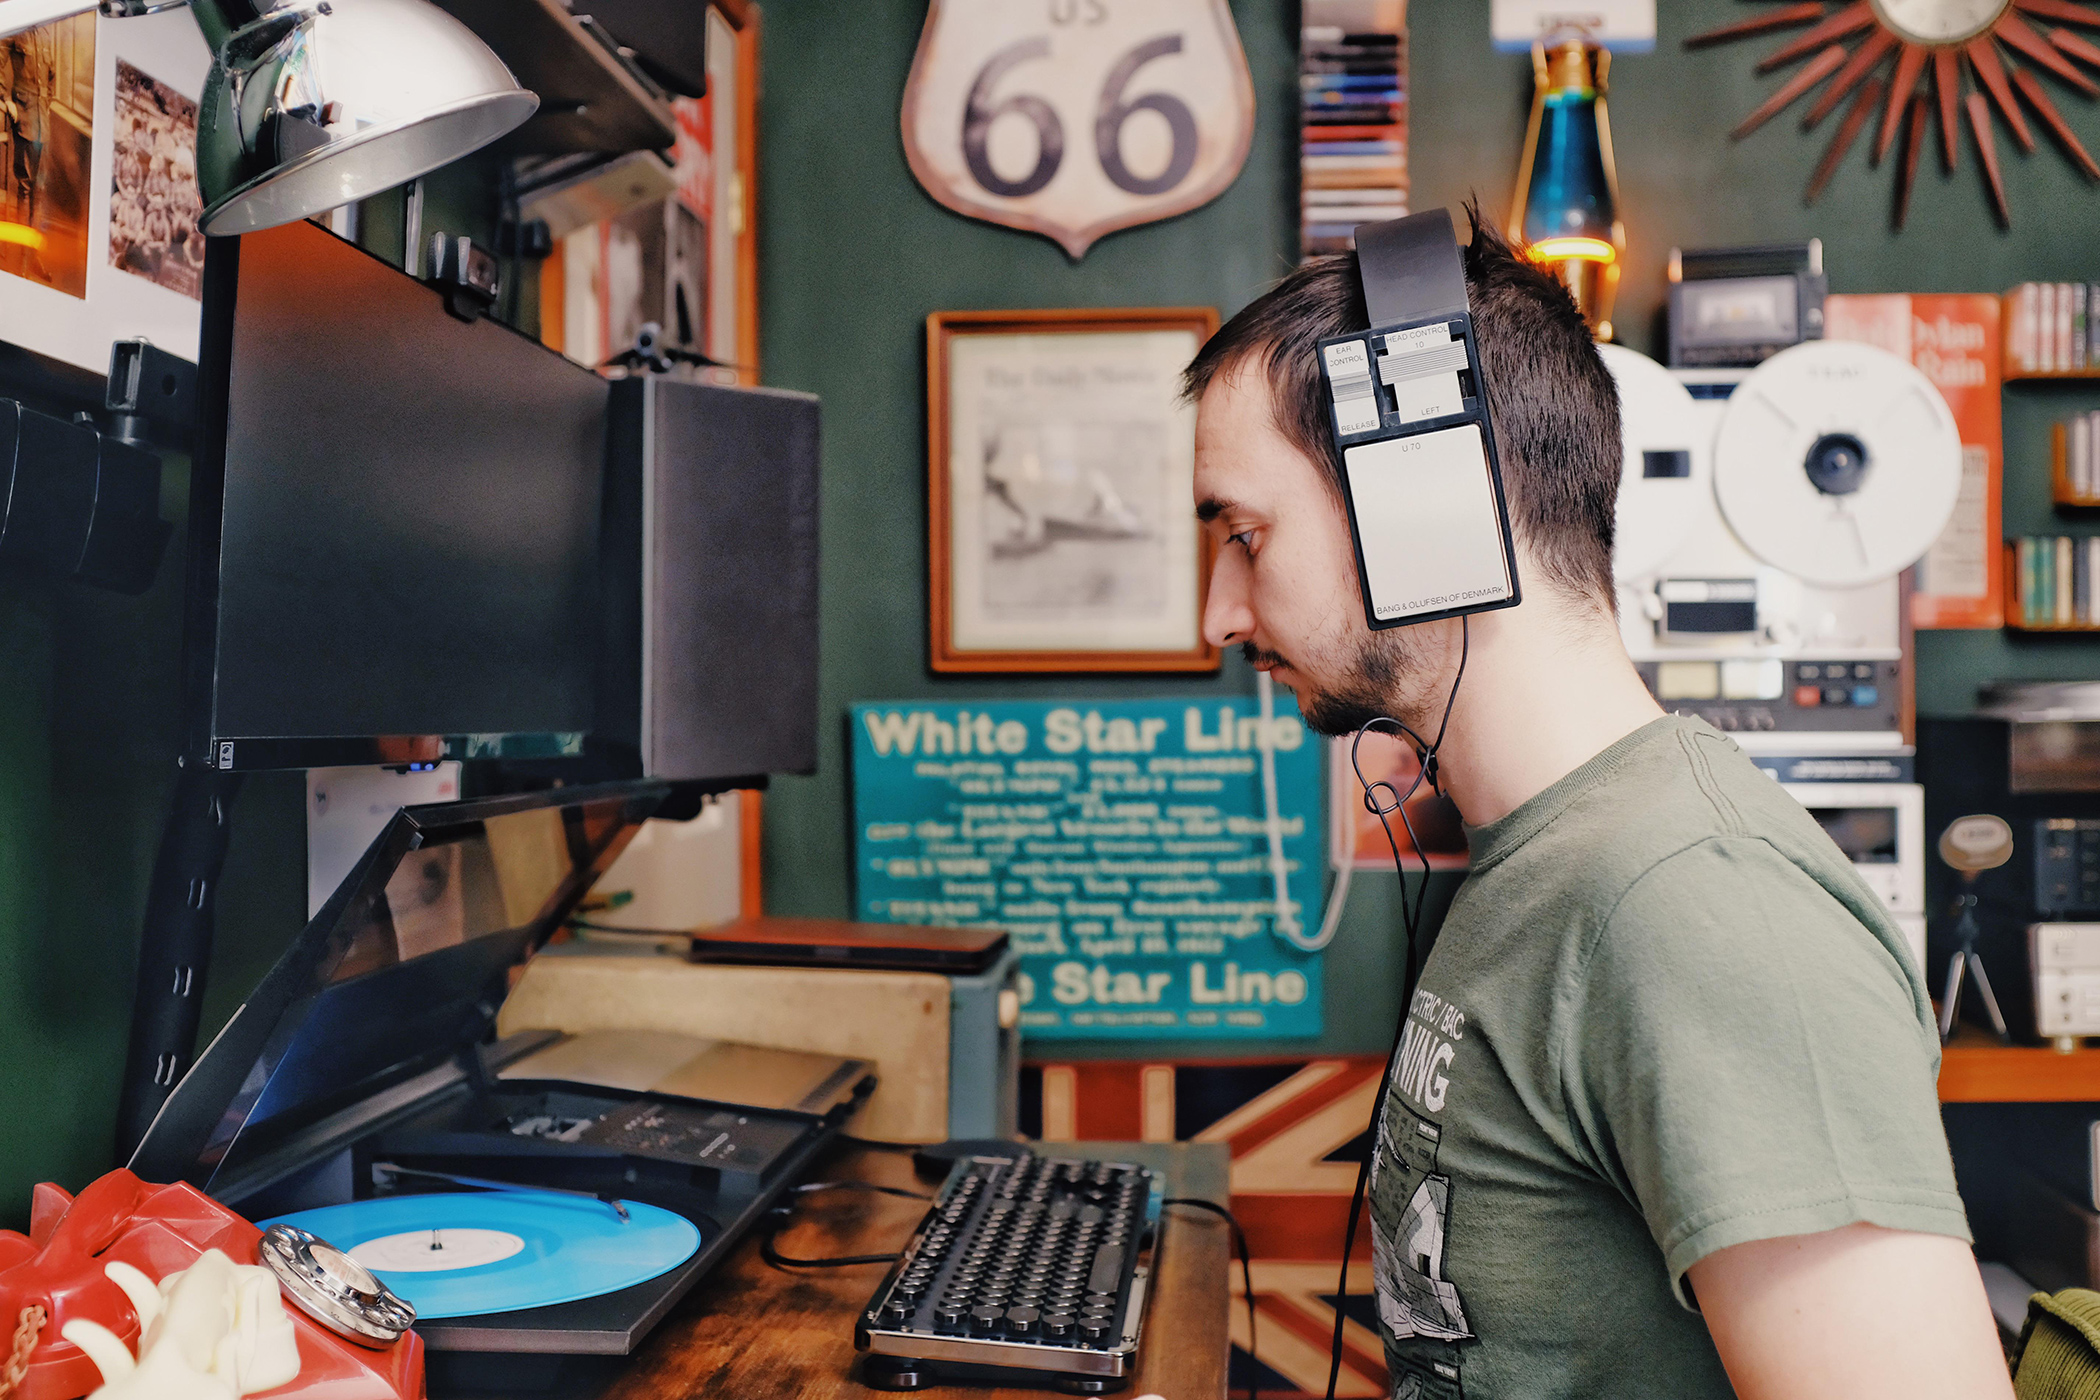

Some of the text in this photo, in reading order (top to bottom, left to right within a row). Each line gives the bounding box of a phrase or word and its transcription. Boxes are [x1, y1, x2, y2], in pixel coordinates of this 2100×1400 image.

[961, 33, 1199, 197] 66
[1386, 325, 1449, 344] HEAD CONTROL
[1335, 345, 1352, 355] EAR
[1415, 341, 1425, 349] 10
[1329, 354, 1364, 367] CONTROL
[1420, 405, 1441, 416] LEFT
[1340, 419, 1377, 433] RELEASE
[1402, 442, 1421, 453] U 70
[1376, 585, 1505, 615] BANG & OLUFSEN OF DENMARK
[865, 706, 1304, 756] White Star Line
[1051, 961, 1171, 1004] Star
[1189, 961, 1307, 1003] Line
[1440, 1004, 1465, 1041] BAC
